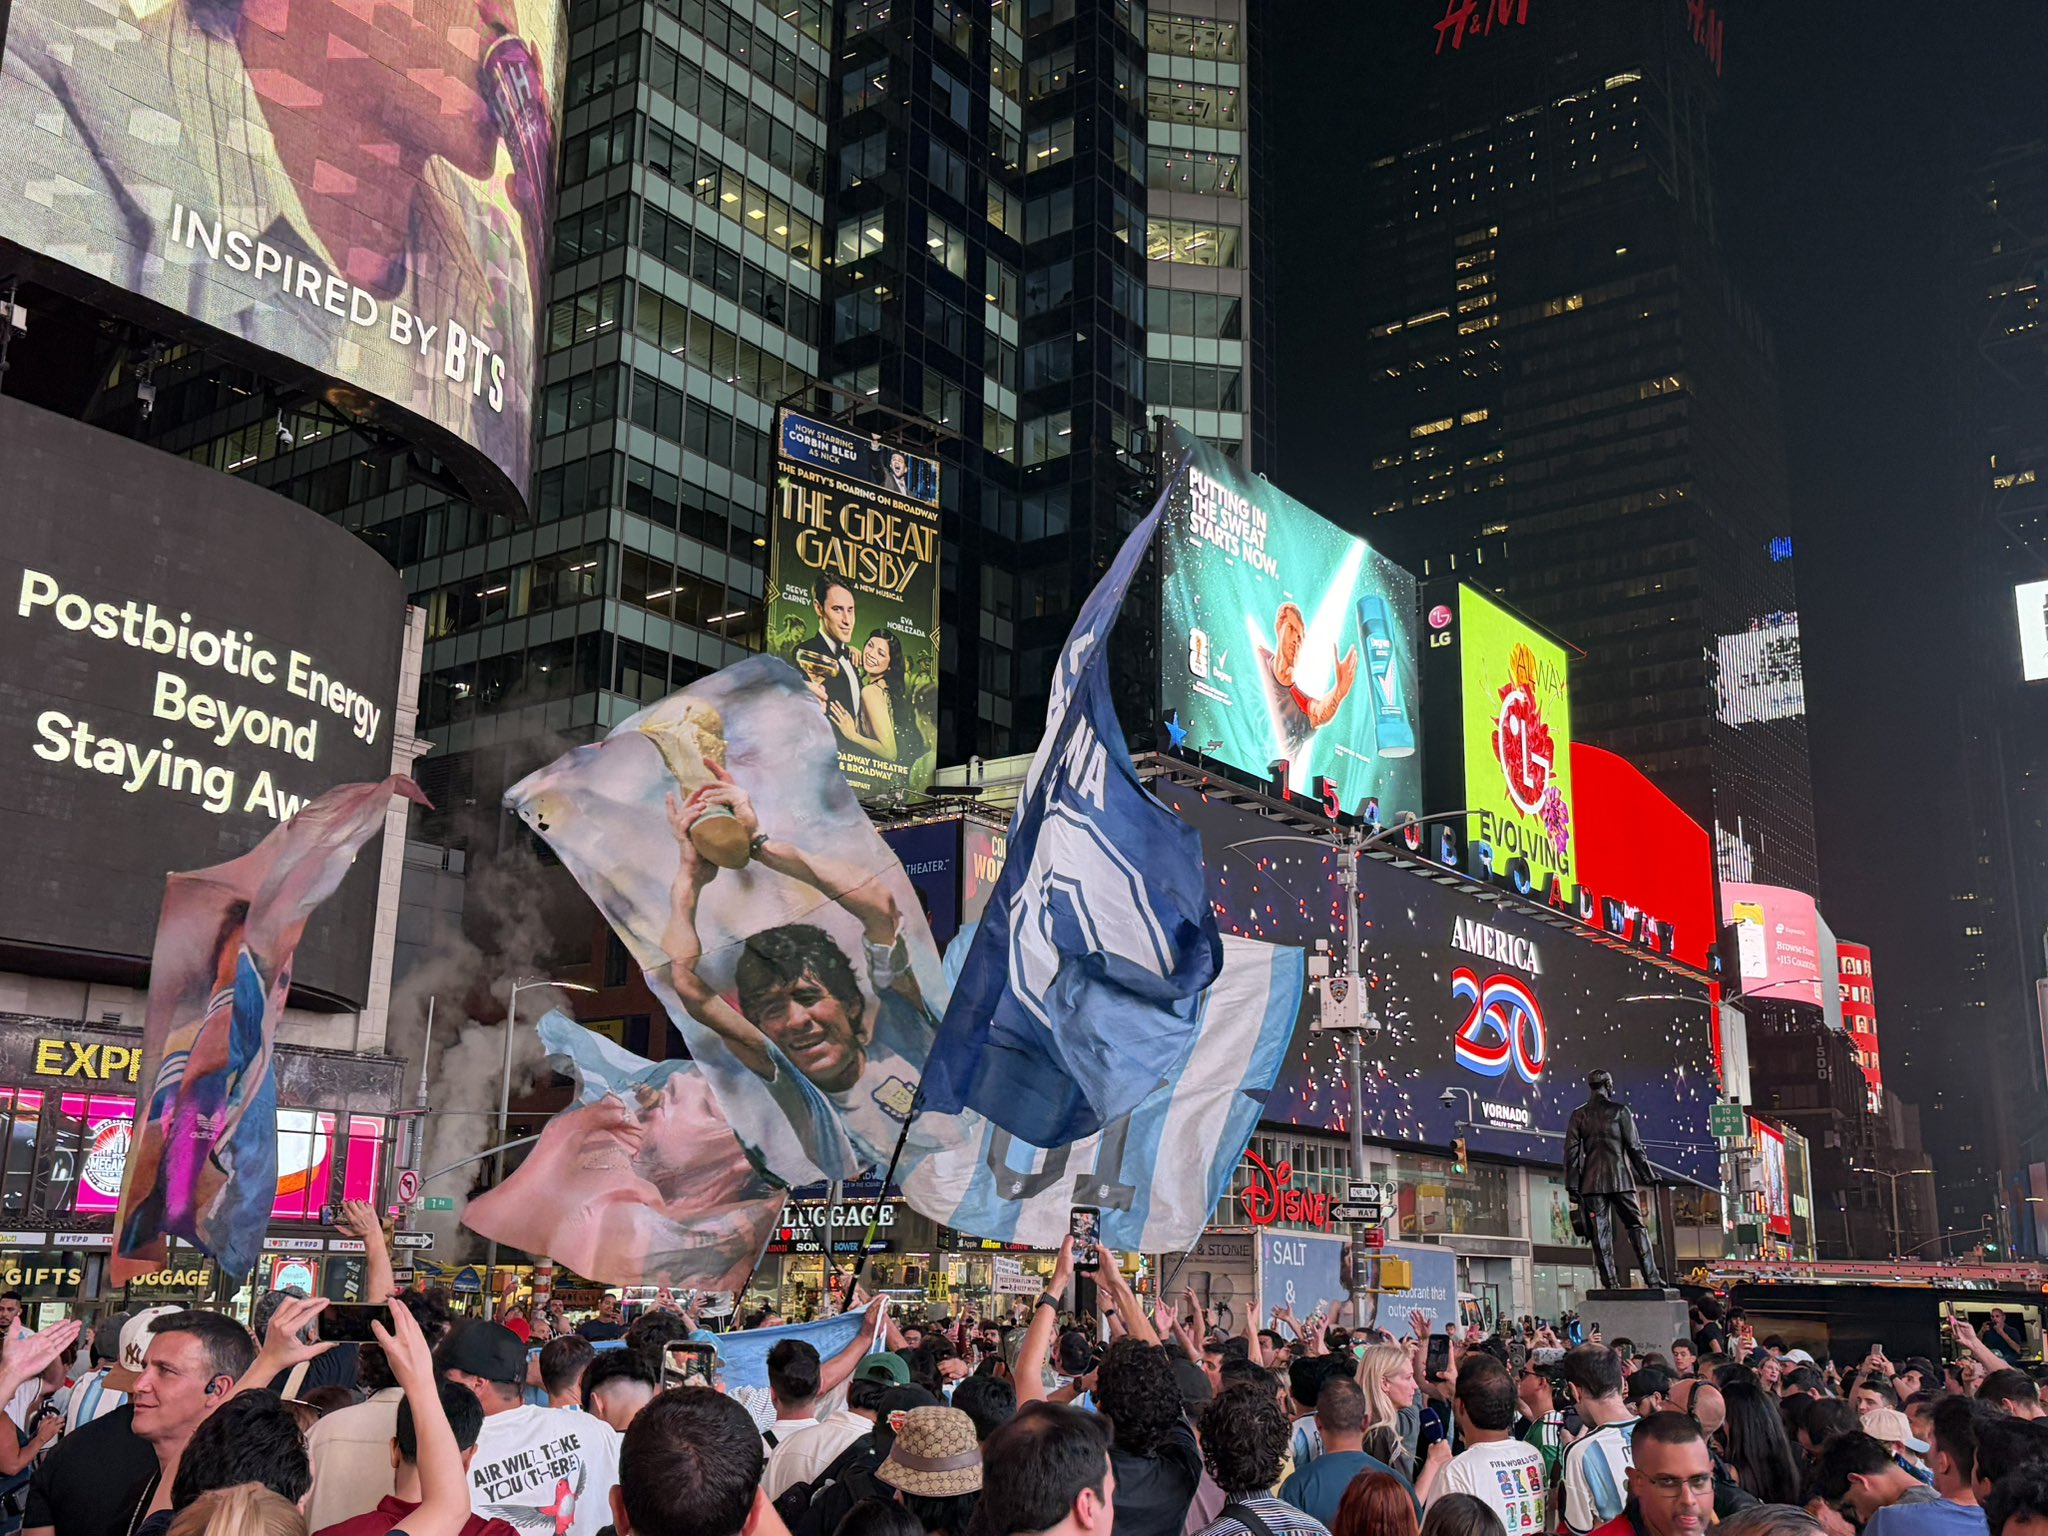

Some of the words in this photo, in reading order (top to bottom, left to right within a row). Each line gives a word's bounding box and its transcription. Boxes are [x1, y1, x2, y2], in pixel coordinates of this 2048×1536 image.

[169, 203, 378, 328] INSPIRED
[389, 303, 438, 356] BY
[444, 318, 507, 413] BTS
[788, 430, 829, 451] CORBIN
[831, 442, 857, 461] BLEU
[795, 423, 815, 437] NOW
[816, 430, 854, 450] STARRING
[808, 448, 818, 457] AS
[820, 451, 840, 465] NICK
[777, 461, 797, 476] THE
[797, 468, 834, 488] PARTY'S
[836, 481, 876, 502] ROARING
[877, 494, 891, 506] ON
[892, 500, 938, 522] BROADWAY
[1189, 466, 1249, 520] PUTTING
[1252, 504, 1267, 532] IN
[783, 483, 832, 531] THE
[839, 503, 938, 563] GREAT
[1189, 488, 1217, 523] THE
[1220, 508, 1266, 552] SWEAT
[1189, 512, 1240, 557] STARTS
[1243, 542, 1280, 580] NOW.
[795, 529, 919, 592] GATSBY
[782, 592, 811, 606] CARNEY
[785, 584, 808, 597] REEVE
[860, 584, 874, 594] NEW
[875, 588, 904, 603] MUSICAL
[887, 621, 926, 638] NOBLEZADA
[900, 616, 913, 626] EVA
[1430, 632, 1451, 648] LG
[18, 569, 277, 684] Postbiotic
[287, 650, 381, 745] Energy
[153, 672, 317, 762] Beyond
[32, 711, 235, 814] Staying
[244, 771, 312, 823] Aw
[847, 764, 893, 781] BROADWAY
[872, 759, 909, 776] THEATRE
[1480, 808, 1569, 876] EVOLVING
[1451, 915, 1539, 974] AMERICA
[1816, 1035, 1827, 1079] 1500
[1482, 1101, 1528, 1123] VORNADO
[1721, 1116, 1731, 1124] 45
[1722, 1107, 1731, 1115] TO
[432, 1199, 436, 1208] 7
[1352, 1189, 1362, 1197] ONE
[782, 1204, 894, 1228] LUGGAGE
[1336, 1208, 1351, 1217] ONE
[1358, 1209, 1374, 1217] WAY
[796, 1242, 823, 1252] SON
[963, 1240, 977, 1248] Apple
[1198, 1244, 1206, 1254] &
[1273, 1240, 1307, 1266] SALT
[5, 1267, 81, 1287] GIFTS
[132, 1269, 211, 1287] UGGAGE
[1285, 1279, 1296, 1304] &
[1431, 1286, 1447, 1301] that
[473, 1463, 503, 1488] AIR
[502, 1450, 543, 1475] WILL
[540, 1433, 581, 1460] TAKE
[1489, 1460, 1506, 1468] FIFA
[1506, 1457, 1529, 1468] WORLD
[1528, 1453, 1539, 1462] CUP
[483, 1475, 524, 1504] YOU
